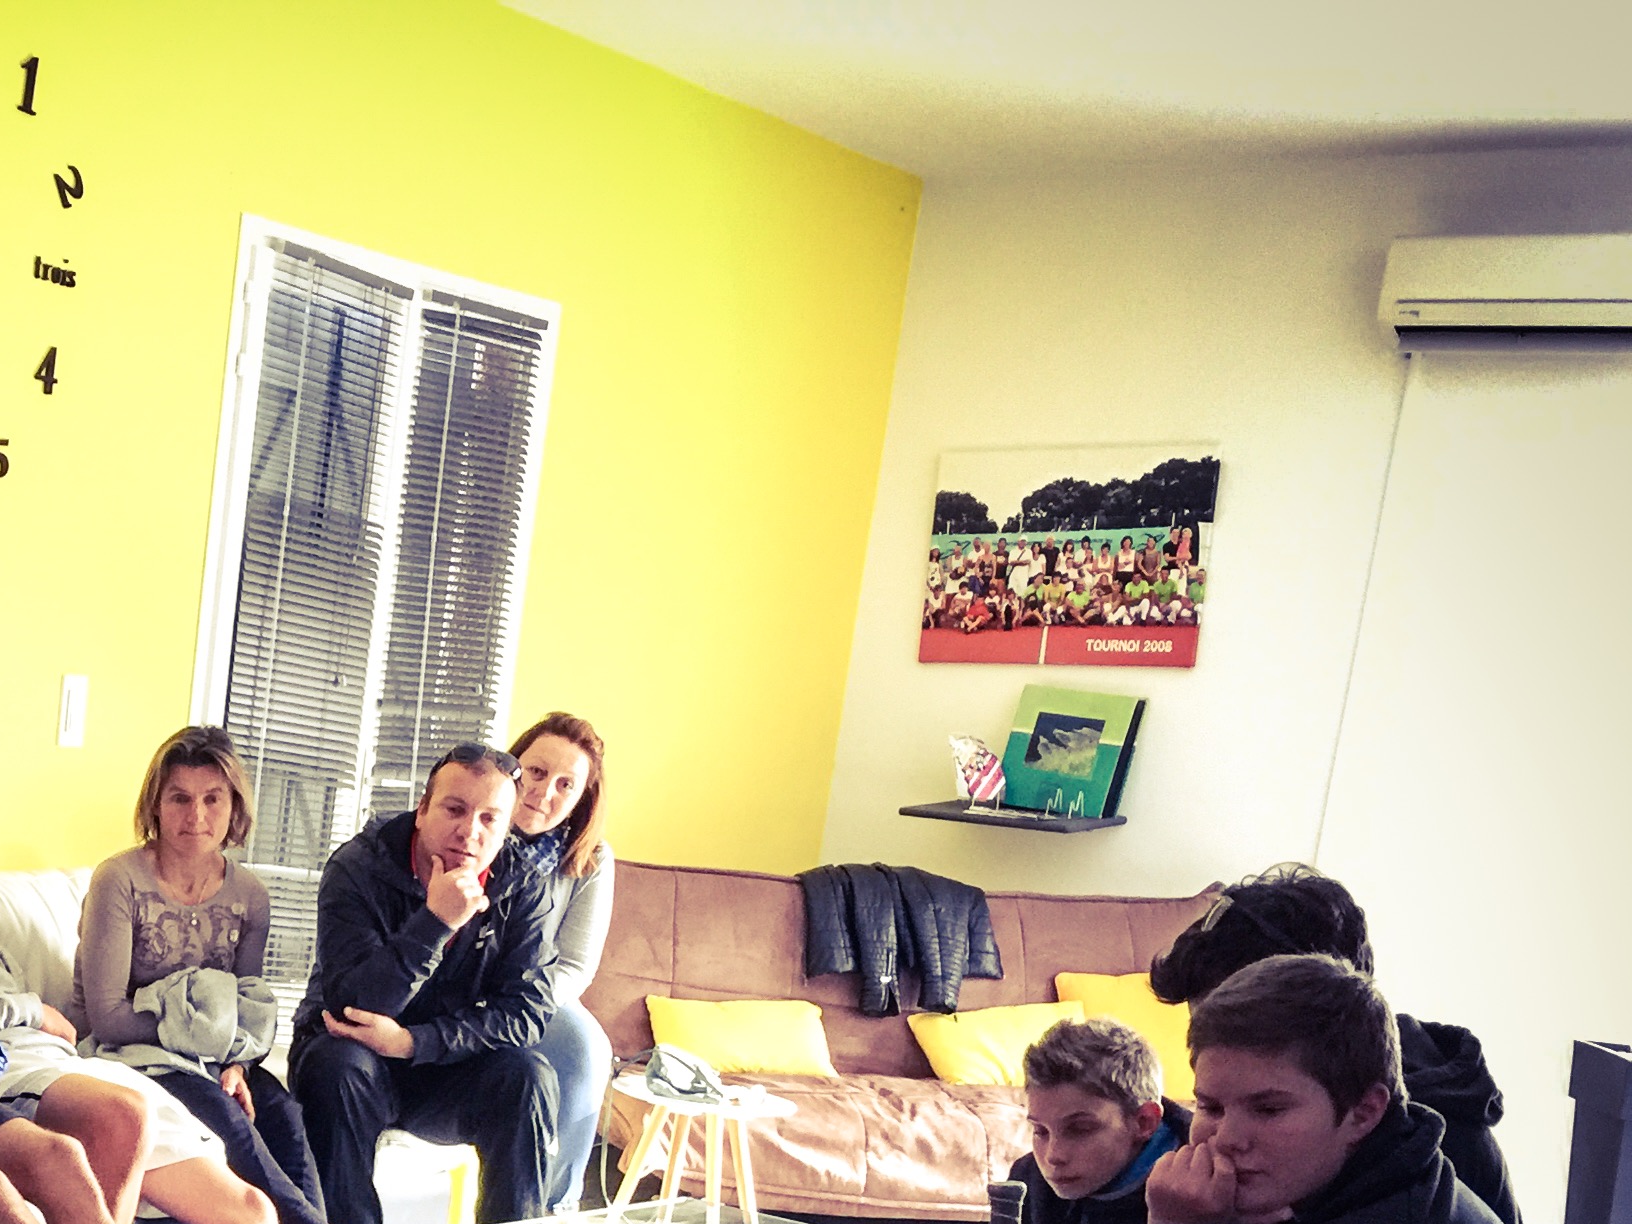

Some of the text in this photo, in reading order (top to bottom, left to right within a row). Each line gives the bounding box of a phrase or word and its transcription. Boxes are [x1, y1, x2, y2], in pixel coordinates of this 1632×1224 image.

[16, 56, 40, 116] 1
[33, 256, 77, 288] trois
[33, 346, 58, 395] 4
[1086, 639, 1173, 653] TOURNOI 2008
